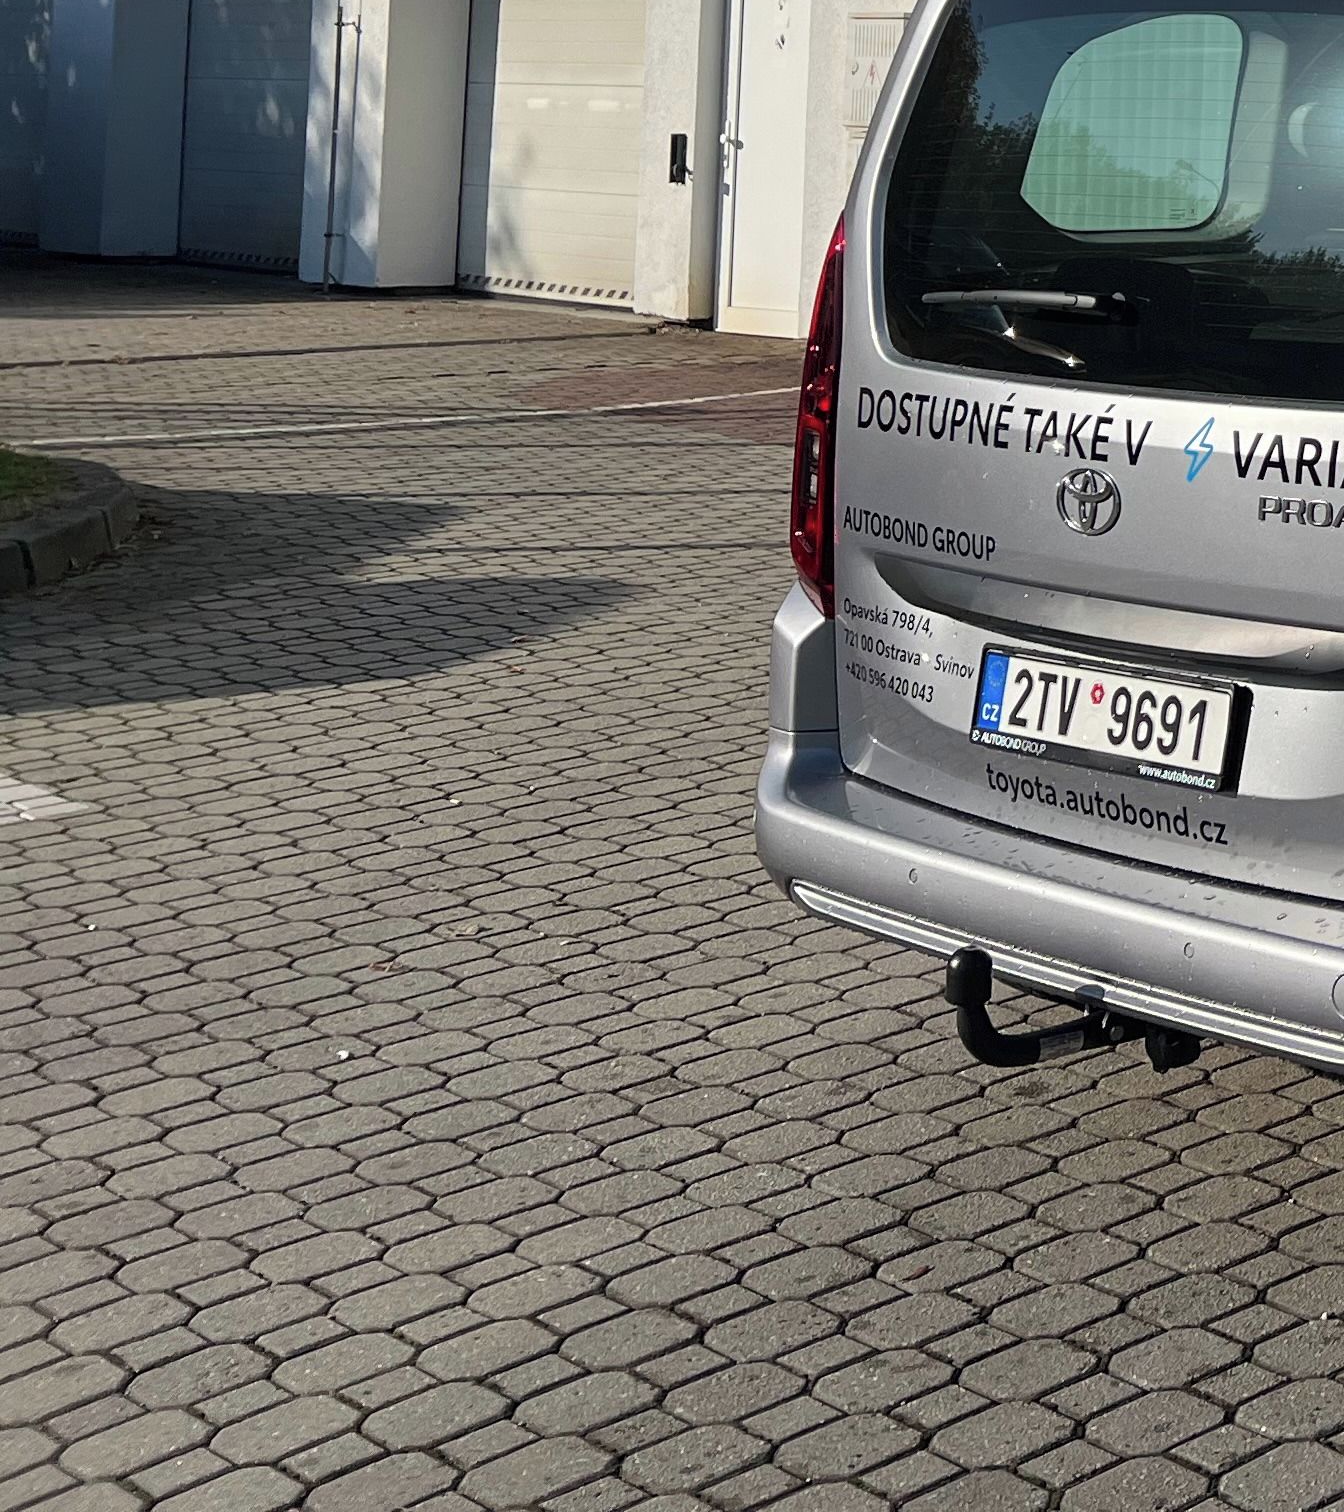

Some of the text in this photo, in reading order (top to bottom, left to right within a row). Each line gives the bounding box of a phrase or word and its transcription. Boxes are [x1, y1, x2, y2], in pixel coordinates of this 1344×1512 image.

[857, 386, 1017, 449] DOSTUPNÉ
[1024, 403, 1116, 463] TAKÉ
[1126, 418, 1153, 466] V
[843, 505, 996, 562] AUTOBOND GROUP
[843, 597, 934, 639] Opavská 798/4,
[844, 628, 975, 679] 721 00 Ostrava Svinov
[845, 661, 935, 703] +420 596 420 043
[981, 703, 999, 723] CZ
[1008, 668, 1208, 761] 2TV 9691
[980, 731, 1047, 756] AUTOBOND GROUP
[1137, 763, 1216, 789] www.autobond.cz
[985, 763, 1229, 846] toyota.autobond.cz
